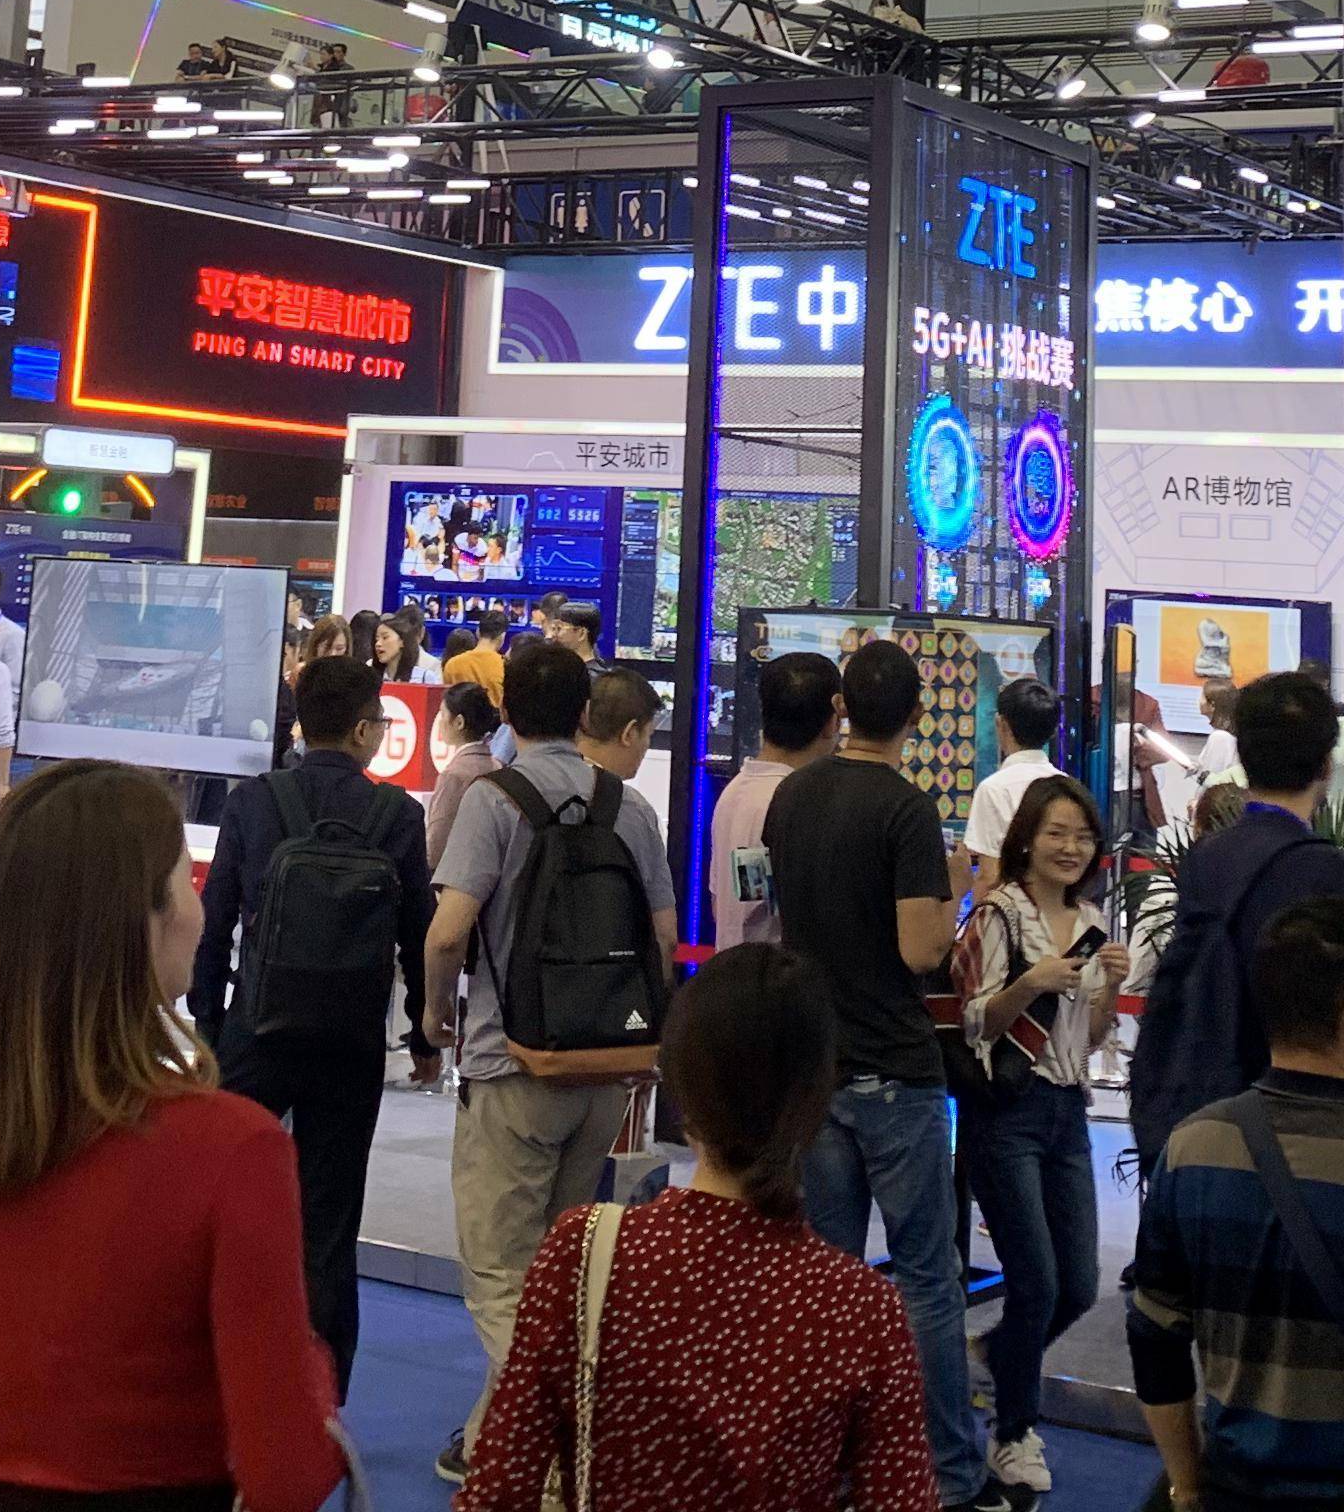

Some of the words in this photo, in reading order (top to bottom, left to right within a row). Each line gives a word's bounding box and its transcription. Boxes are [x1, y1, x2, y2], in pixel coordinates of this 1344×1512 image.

[959, 176, 1038, 279] ZTE
[196, 268, 411, 344] 平安智慧城市
[634, 264, 859, 351] ZE中
[193, 331, 246, 357] PING
[253, 340, 283, 363] AN
[289, 344, 356, 373] SMART
[361, 356, 405, 380] CITY
[912, 306, 994, 368] 5G+AI
[999, 322, 1075, 390] 挑战赛
[575, 440, 670, 469] 平安城市
[1162, 474, 1293, 508] AR博物馆
